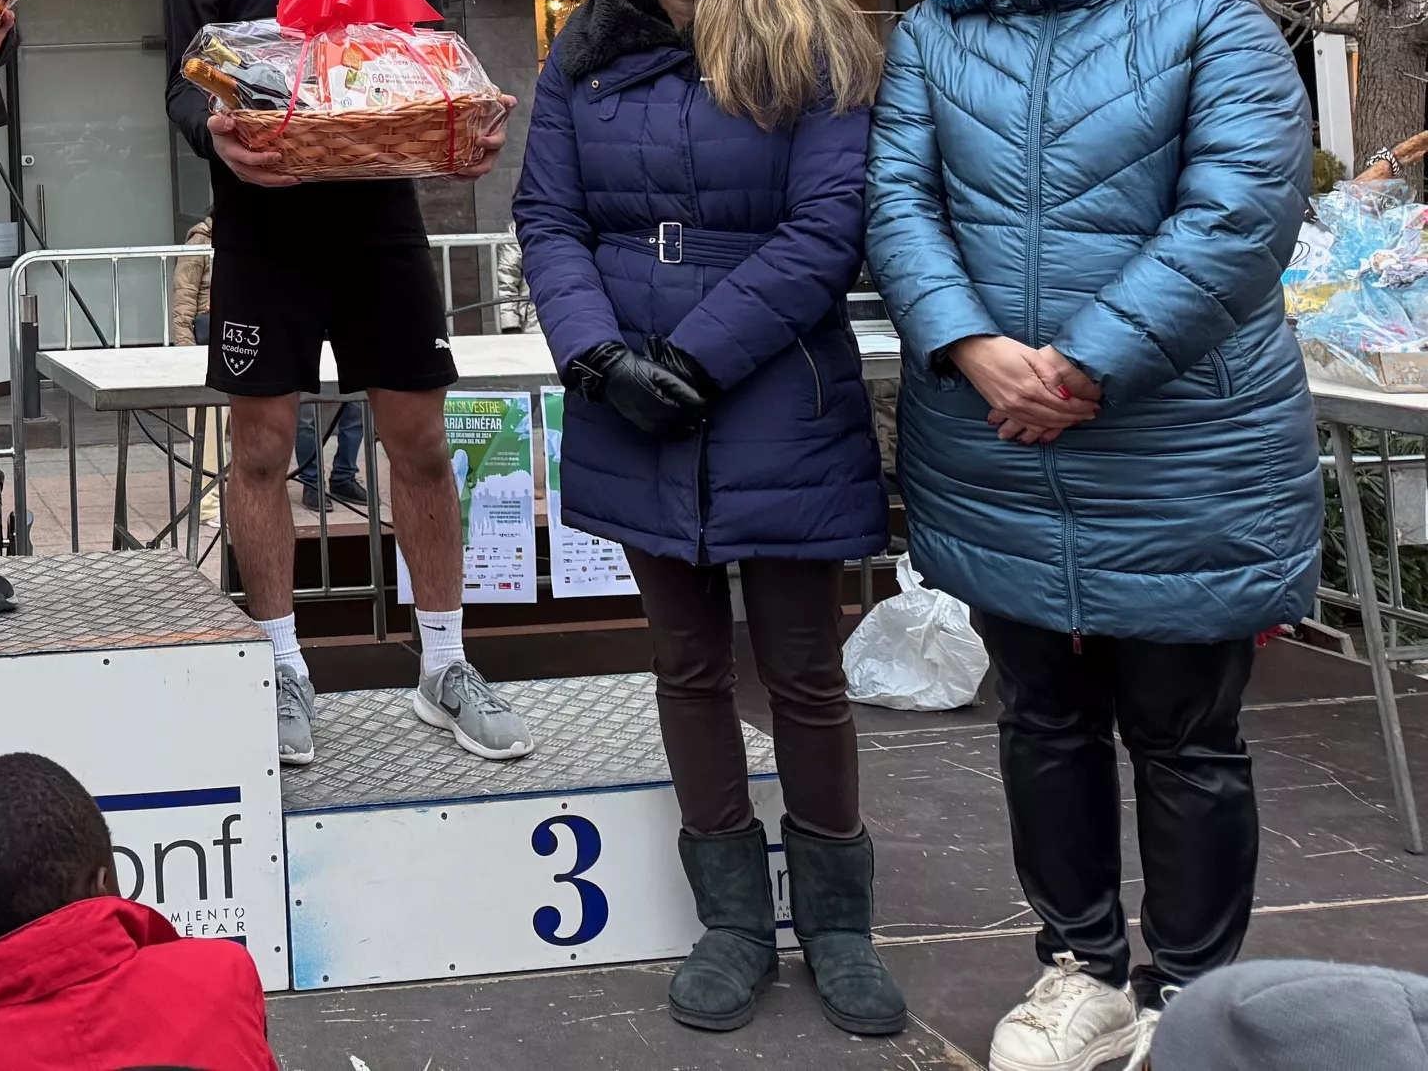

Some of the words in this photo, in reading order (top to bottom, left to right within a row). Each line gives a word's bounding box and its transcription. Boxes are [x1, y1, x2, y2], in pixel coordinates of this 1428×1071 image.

[221, 343, 259, 357] academy
[457, 401, 501, 413] SILVESTRE
[466, 415, 502, 430] BINÉFAR
[531, 815, 609, 947] 3
[171, 907, 245, 923] MIENTO
[185, 921, 246, 937] ÉFAR
